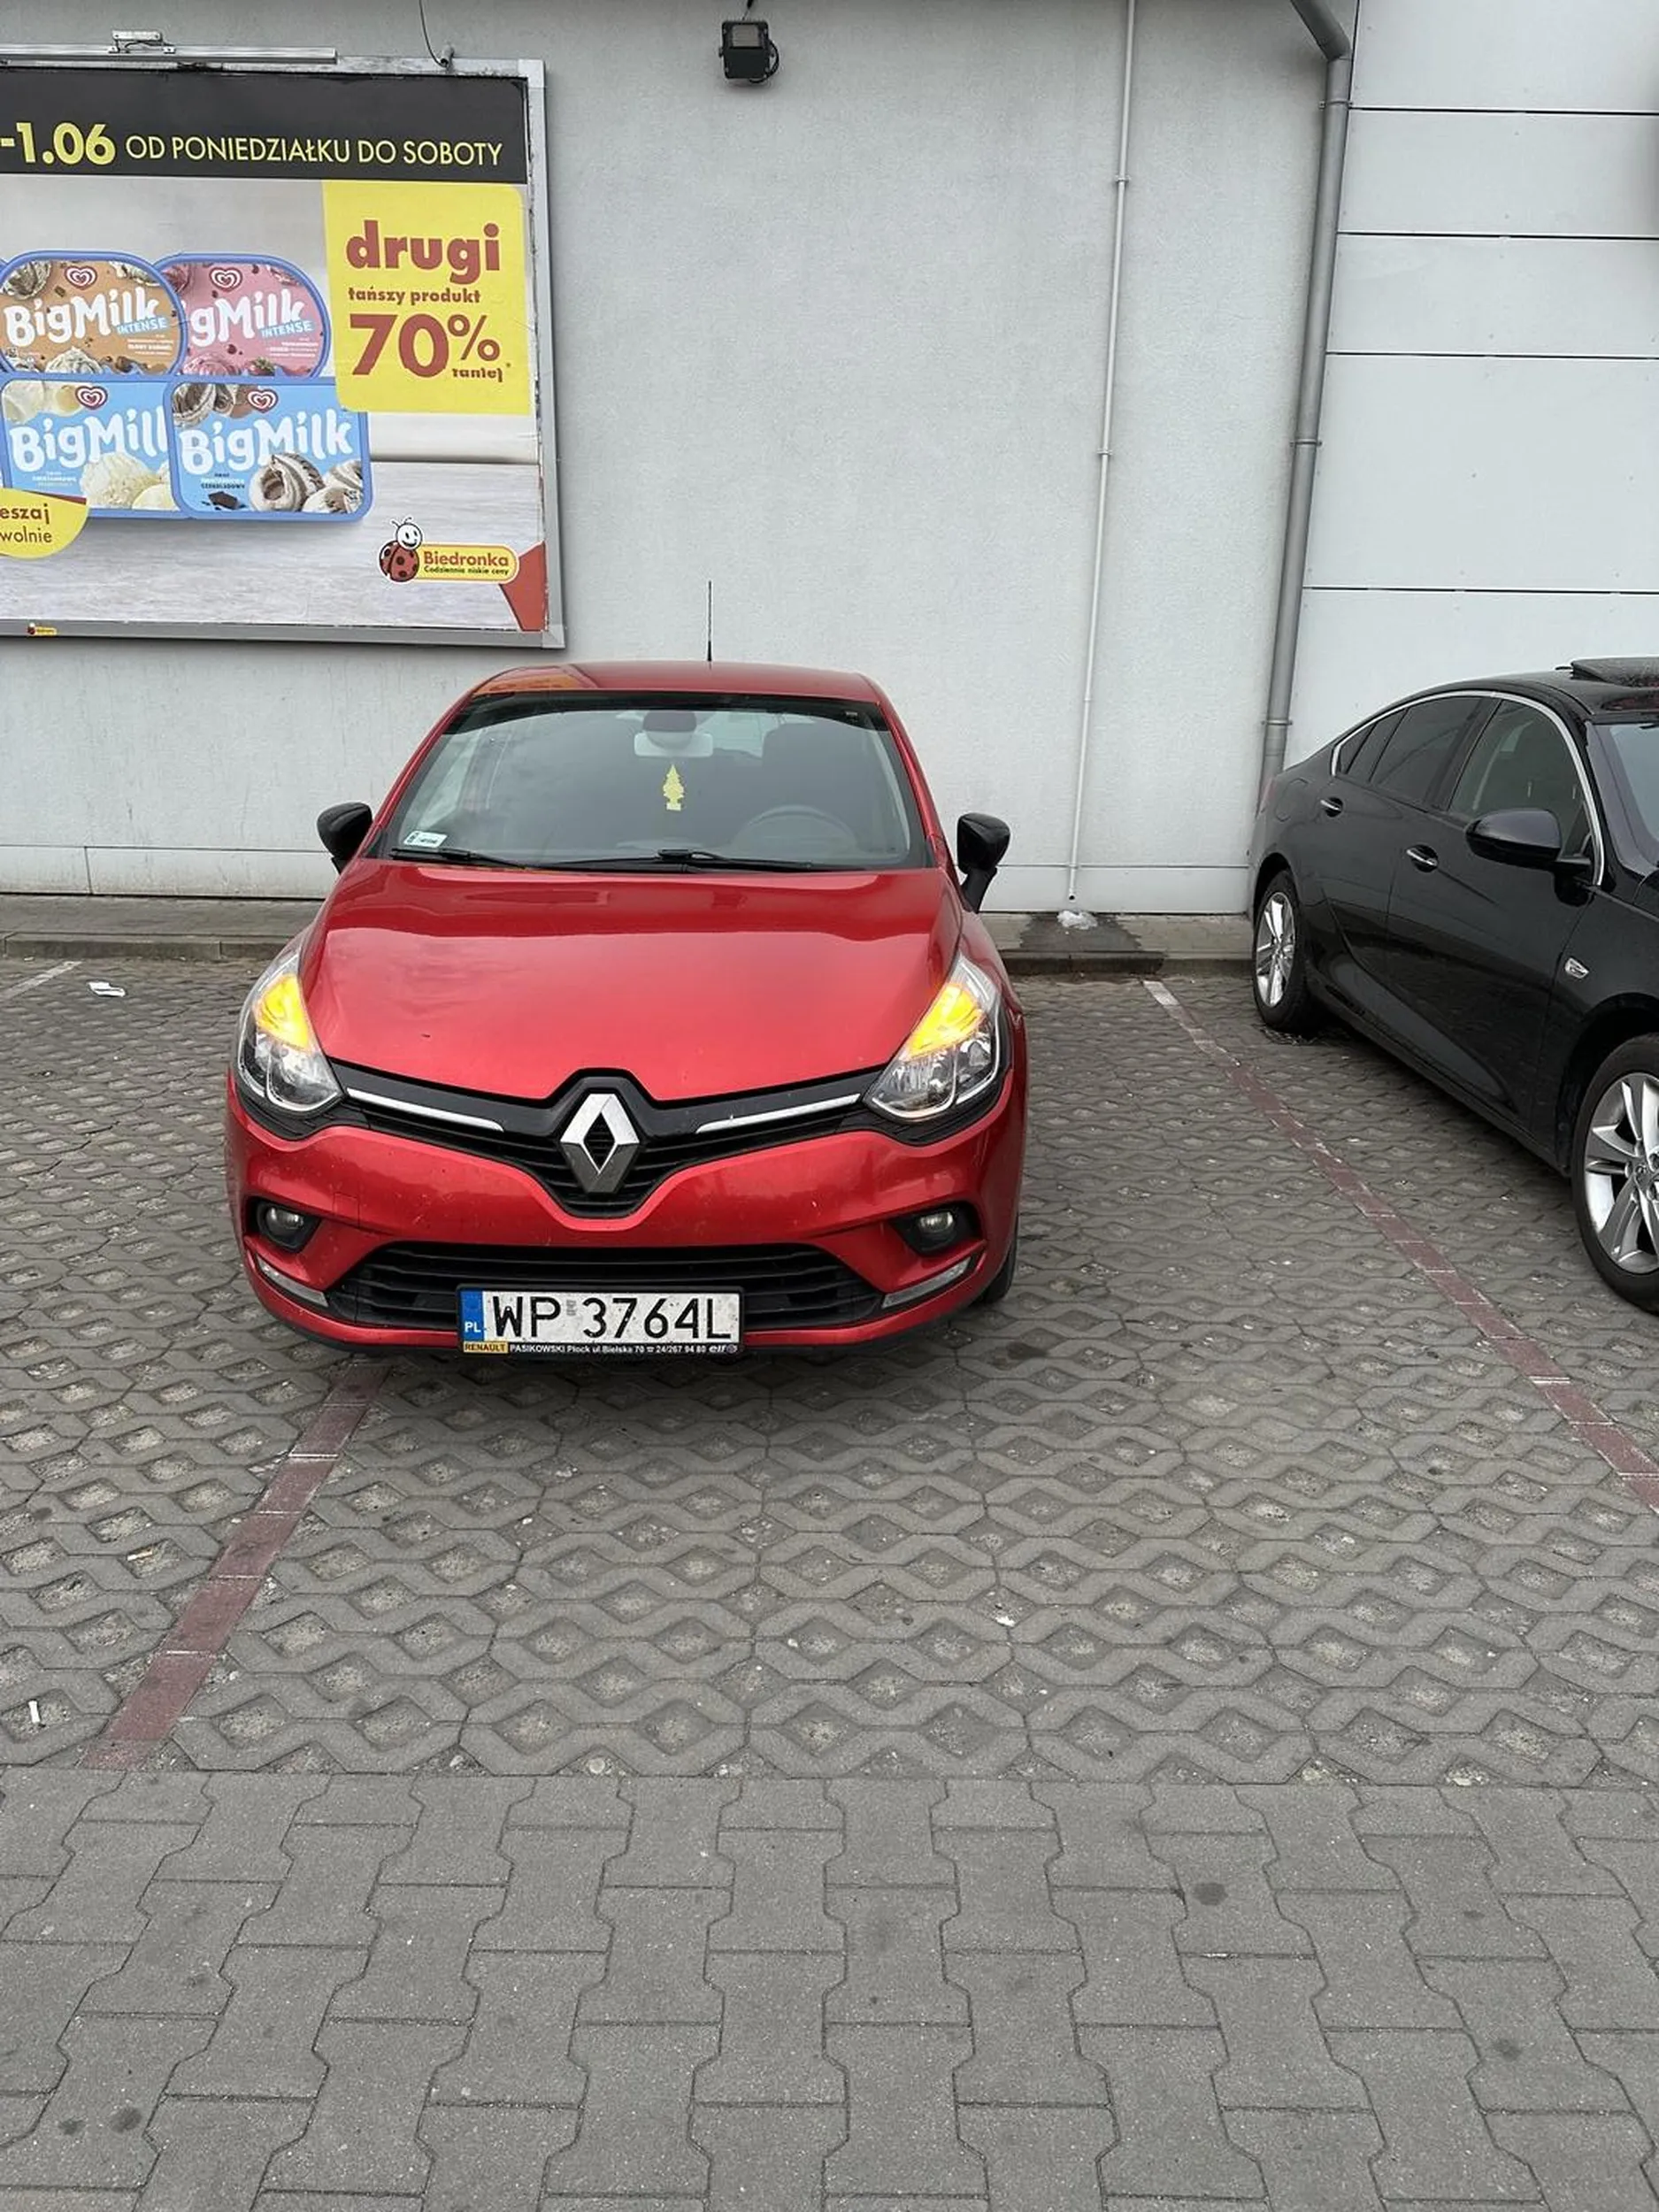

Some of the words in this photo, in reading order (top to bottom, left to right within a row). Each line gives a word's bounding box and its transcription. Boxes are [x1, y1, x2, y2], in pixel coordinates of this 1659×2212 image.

[1, 122, 116, 165] -1.06
[126, 135, 165, 159] OD
[172, 136, 350, 163] PONIEDZIAŁKU
[357, 140, 396, 164] DO
[403, 141, 503, 165] SOBOTY
[346, 219, 500, 285] drugi
[348, 286, 405, 305] tańszy
[410, 288, 480, 305] produkt
[4, 286, 159, 347] BigMilk
[116, 317, 168, 335] INTENSE
[181, 288, 305, 348] gMilk
[259, 319, 313, 337] INTENSE
[349, 313, 501, 378] 70%
[179, 408, 354, 475] BigMilk
[423, 550, 509, 566] Biedronka
[465, 1321, 481, 1333] PL
[493, 1296, 561, 1338] WP
[581, 1297, 732, 1340] 3764L
[464, 1342, 506, 1353] RENAULT
[509, 1344, 565, 1354] PASIKOWSKI
[709, 1344, 726, 1354] elf
